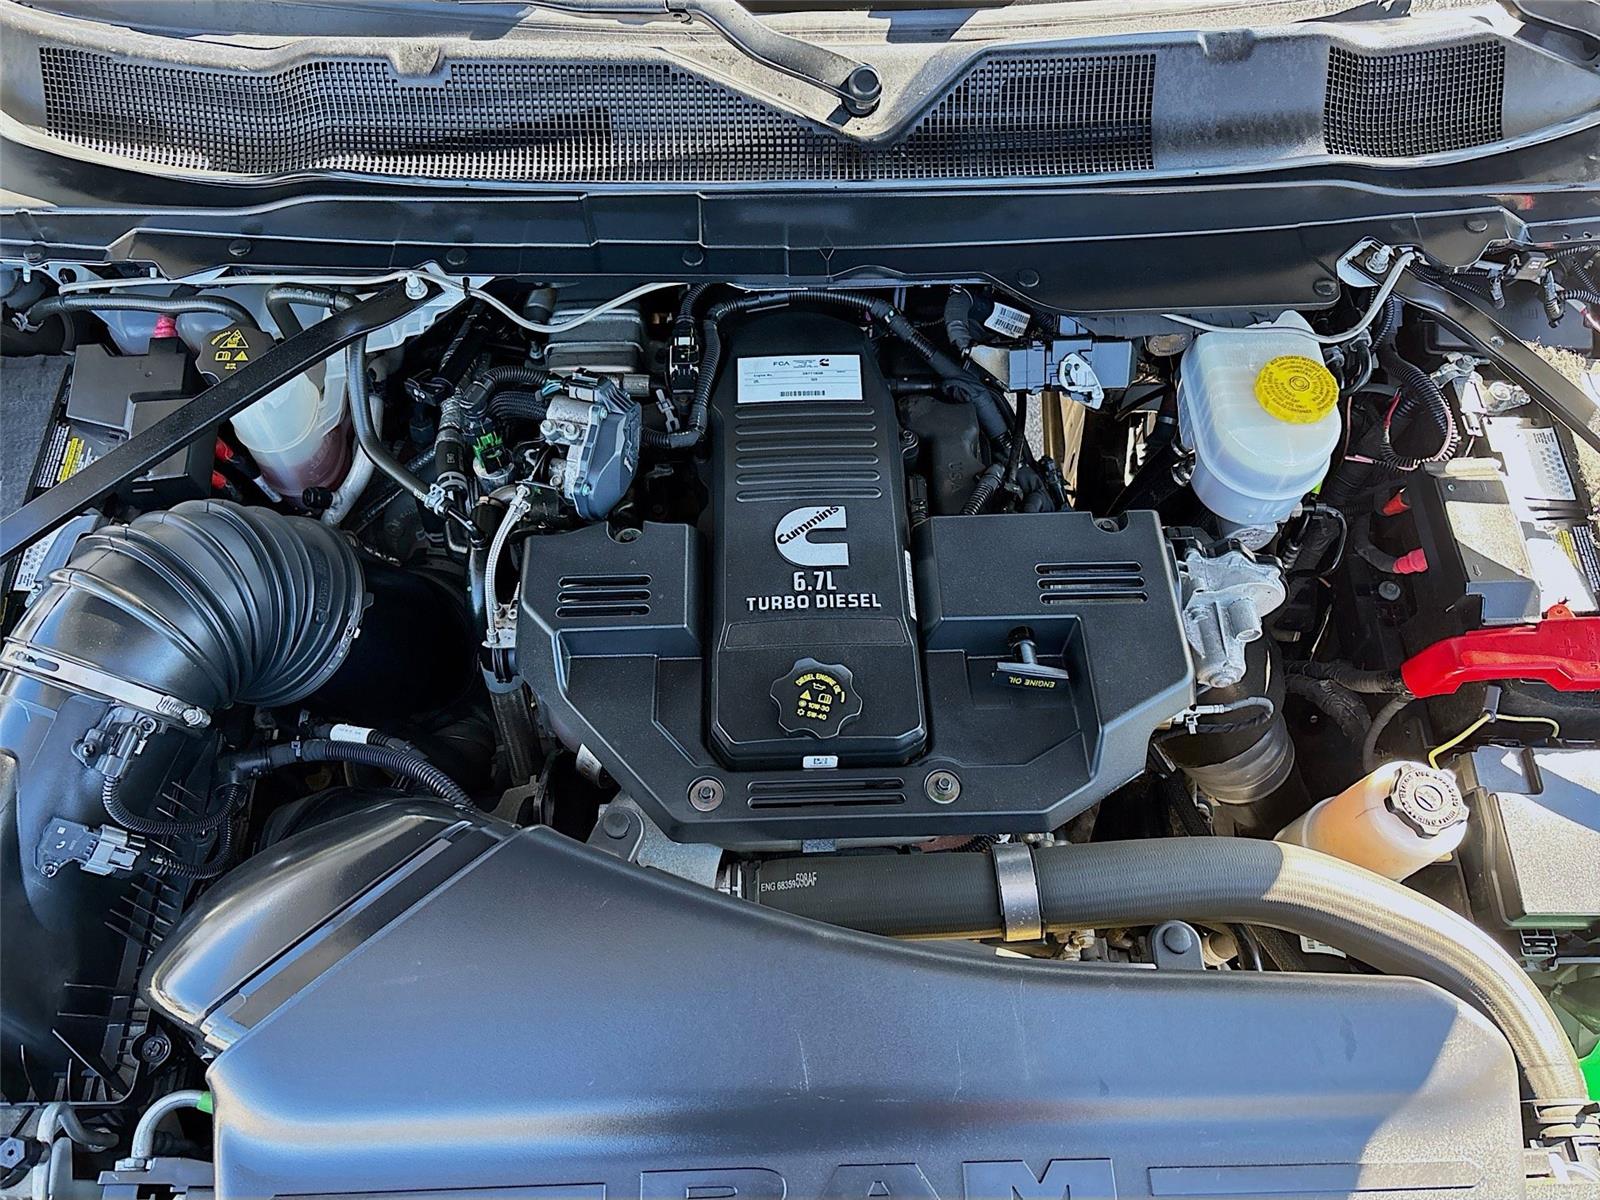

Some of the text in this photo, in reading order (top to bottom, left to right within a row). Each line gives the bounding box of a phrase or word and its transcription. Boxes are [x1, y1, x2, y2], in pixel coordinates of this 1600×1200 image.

[776, 505, 840, 545] Cummins
[793, 571, 837, 591] 6.7L
[746, 593, 882, 611] TURBO DIESEL
[816, 672, 837, 687] ENGINE
[1008, 676, 1056, 688] ENGINE OIL
[760, 882, 776, 892] ENG
